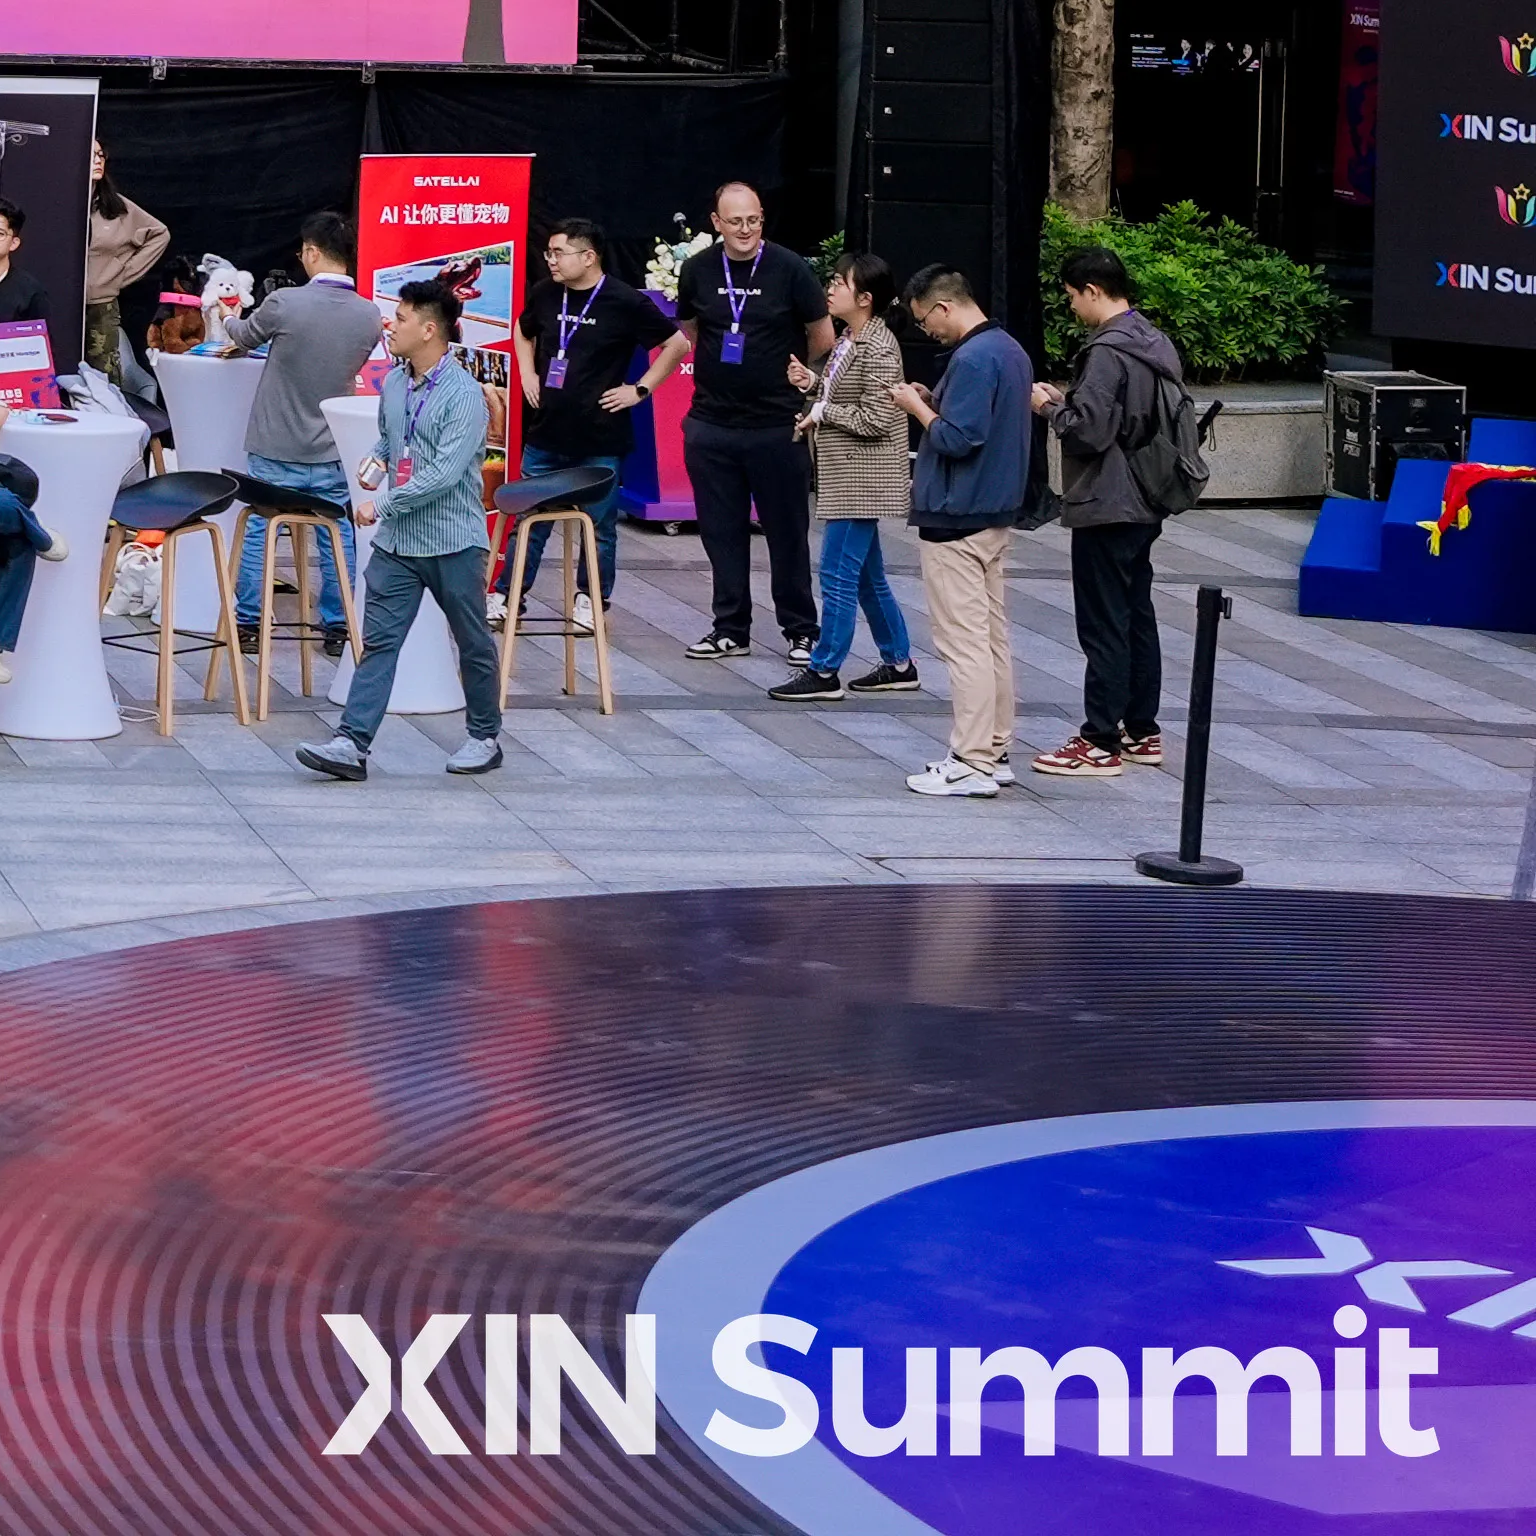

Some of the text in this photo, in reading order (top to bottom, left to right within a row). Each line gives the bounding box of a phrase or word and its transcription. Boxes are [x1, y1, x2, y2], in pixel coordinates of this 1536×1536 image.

[1439, 113, 1493, 141] XIN
[413, 176, 480, 187] SATELLAI
[380, 202, 510, 225] AI 让你更懂宠物
[1436, 261, 1489, 291] XIN
